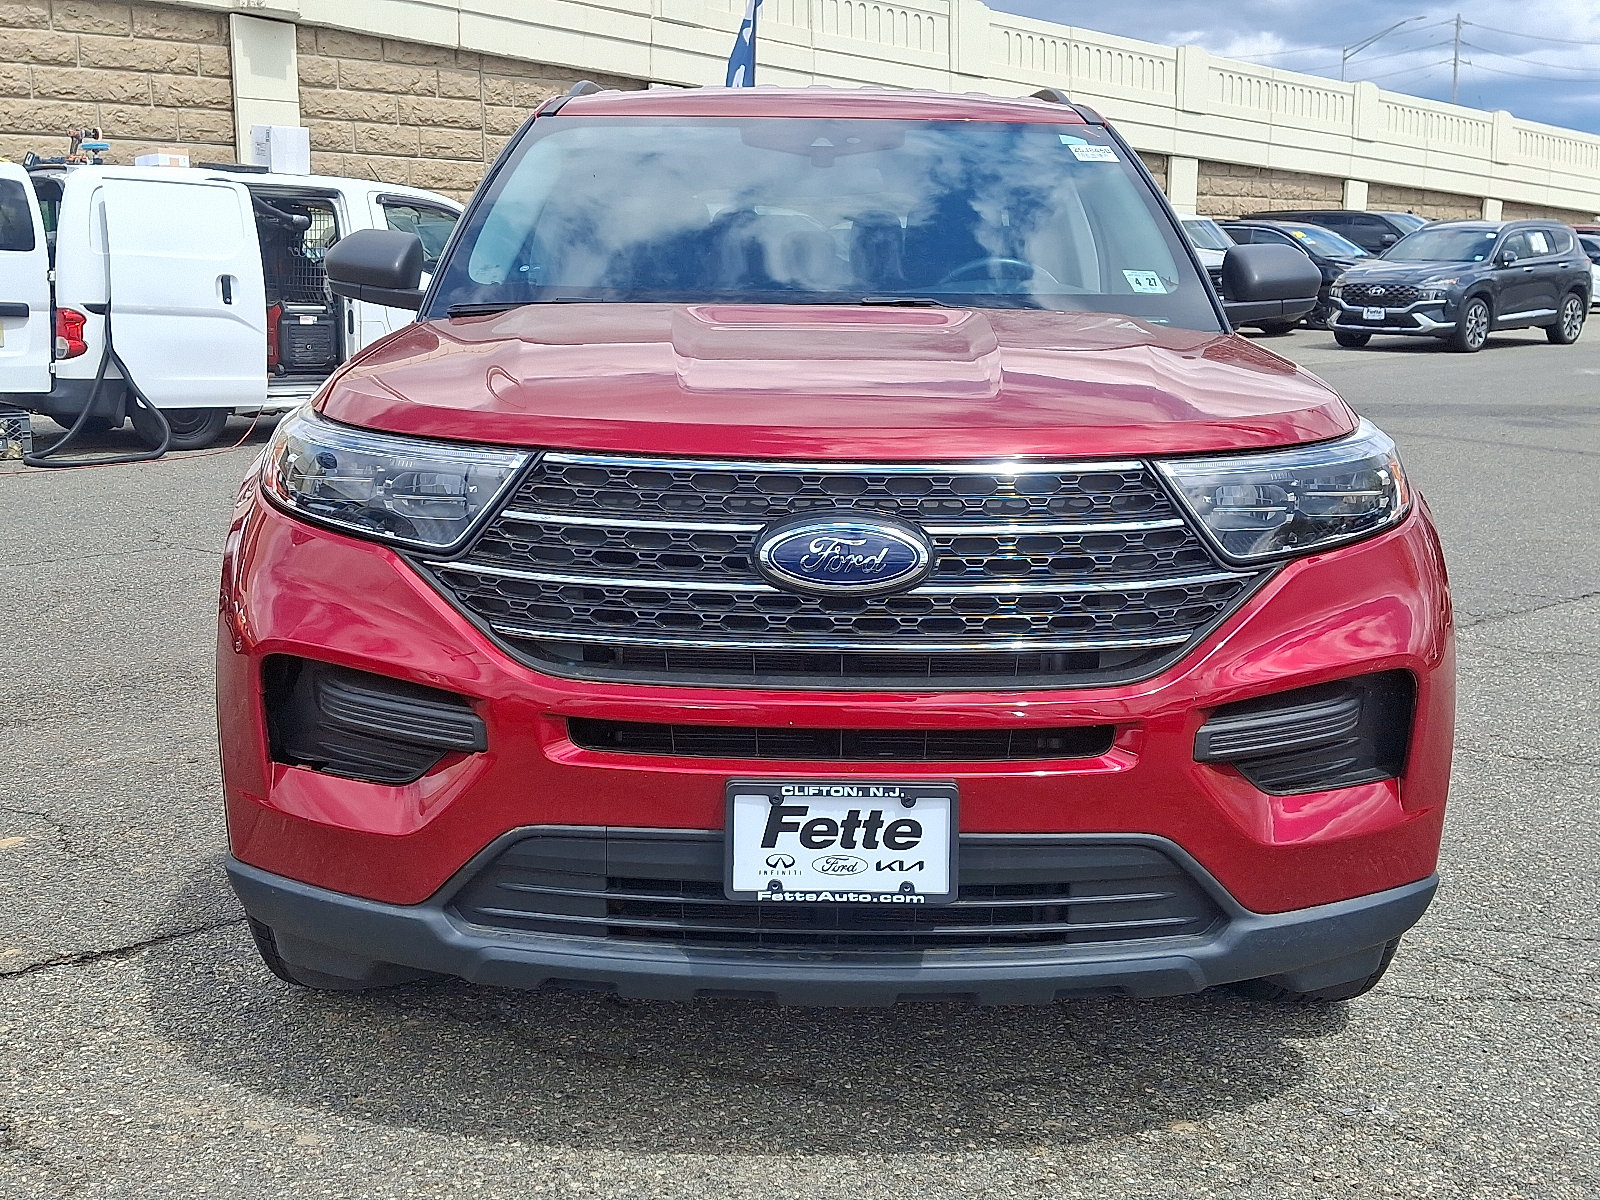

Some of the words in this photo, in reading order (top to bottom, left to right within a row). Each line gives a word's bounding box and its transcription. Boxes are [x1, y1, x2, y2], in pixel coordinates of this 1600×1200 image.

[1135, 277, 1142, 287] 4
[1145, 277, 1158, 287] 27
[800, 536, 890, 573] Ford
[781, 786, 863, 797] CLIFTON,
[869, 787, 905, 798] N.J.
[760, 805, 923, 851] Fette
[821, 857, 858, 874] Ford
[757, 891, 925, 904] FetteAuto.com
